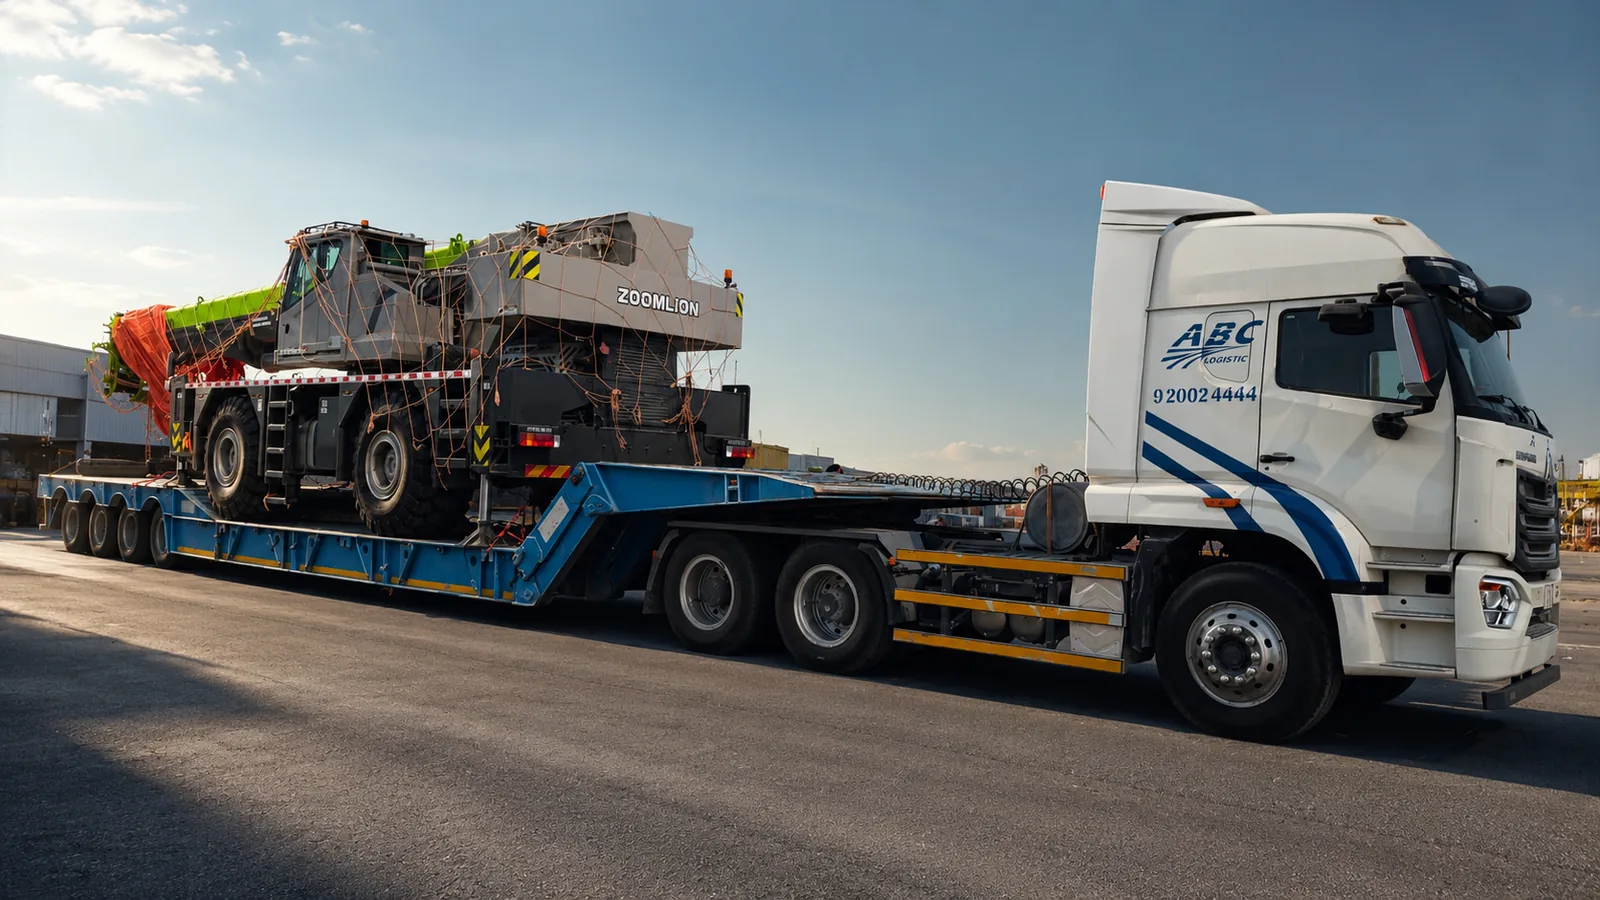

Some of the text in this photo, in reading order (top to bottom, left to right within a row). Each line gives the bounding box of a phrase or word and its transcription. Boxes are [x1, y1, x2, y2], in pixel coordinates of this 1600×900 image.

[617, 286, 699, 317] ZOOMLION
[1171, 320, 1264, 347] ABC
[1204, 355, 1248, 364] LOGISTIC
